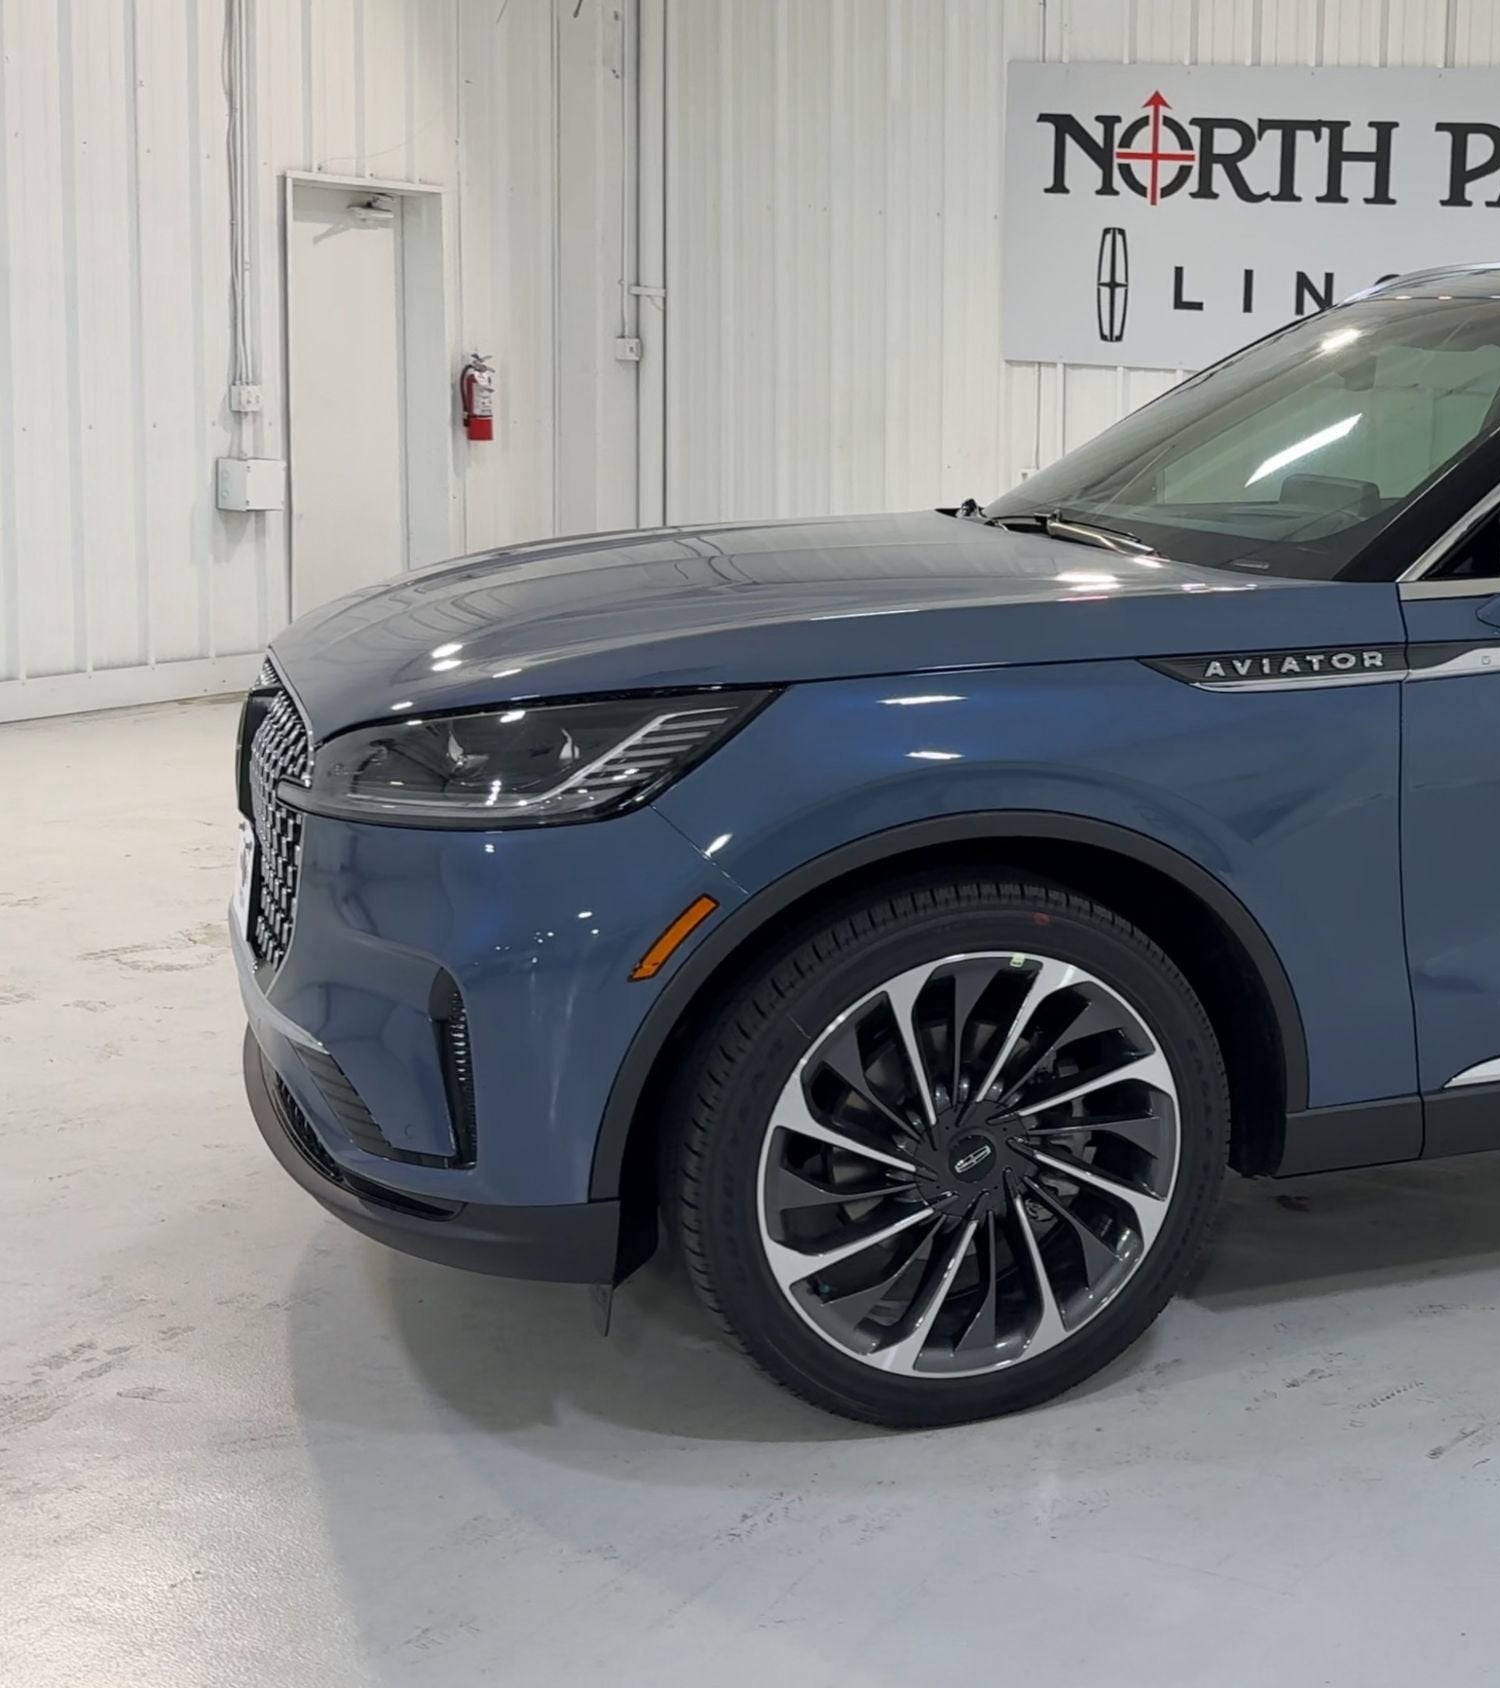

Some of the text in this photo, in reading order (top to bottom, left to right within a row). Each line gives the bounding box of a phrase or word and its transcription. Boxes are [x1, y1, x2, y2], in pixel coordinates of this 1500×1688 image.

[1036, 111, 1400, 206] NORTH
[1173, 265, 1400, 316] LIN
[1204, 651, 1384, 678] AVIATOR
